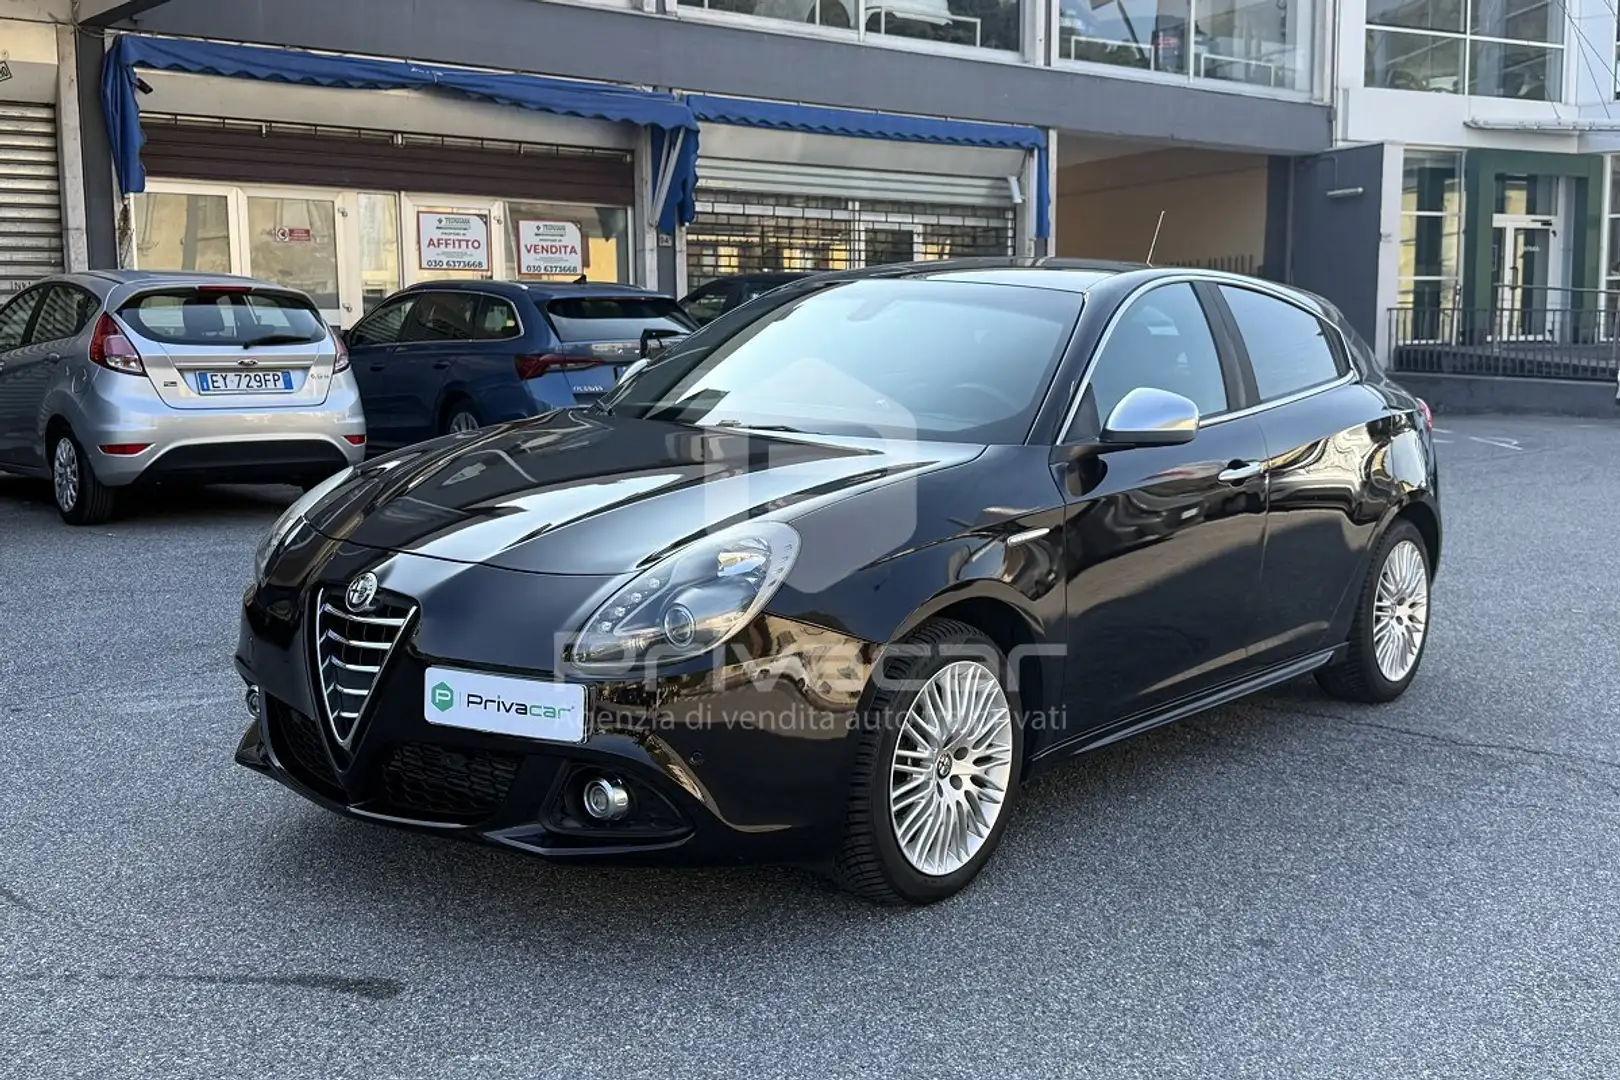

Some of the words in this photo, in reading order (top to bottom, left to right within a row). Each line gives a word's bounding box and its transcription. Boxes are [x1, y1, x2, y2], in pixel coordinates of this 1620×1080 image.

[427, 238, 481, 250] AFFITTO
[524, 243, 578, 255] VENDITA
[426, 260, 444, 268] 030
[526, 264, 542, 273] 030
[210, 373, 228, 389] EY
[234, 373, 281, 389] 729FP
[467, 692, 572, 720] Privacar
